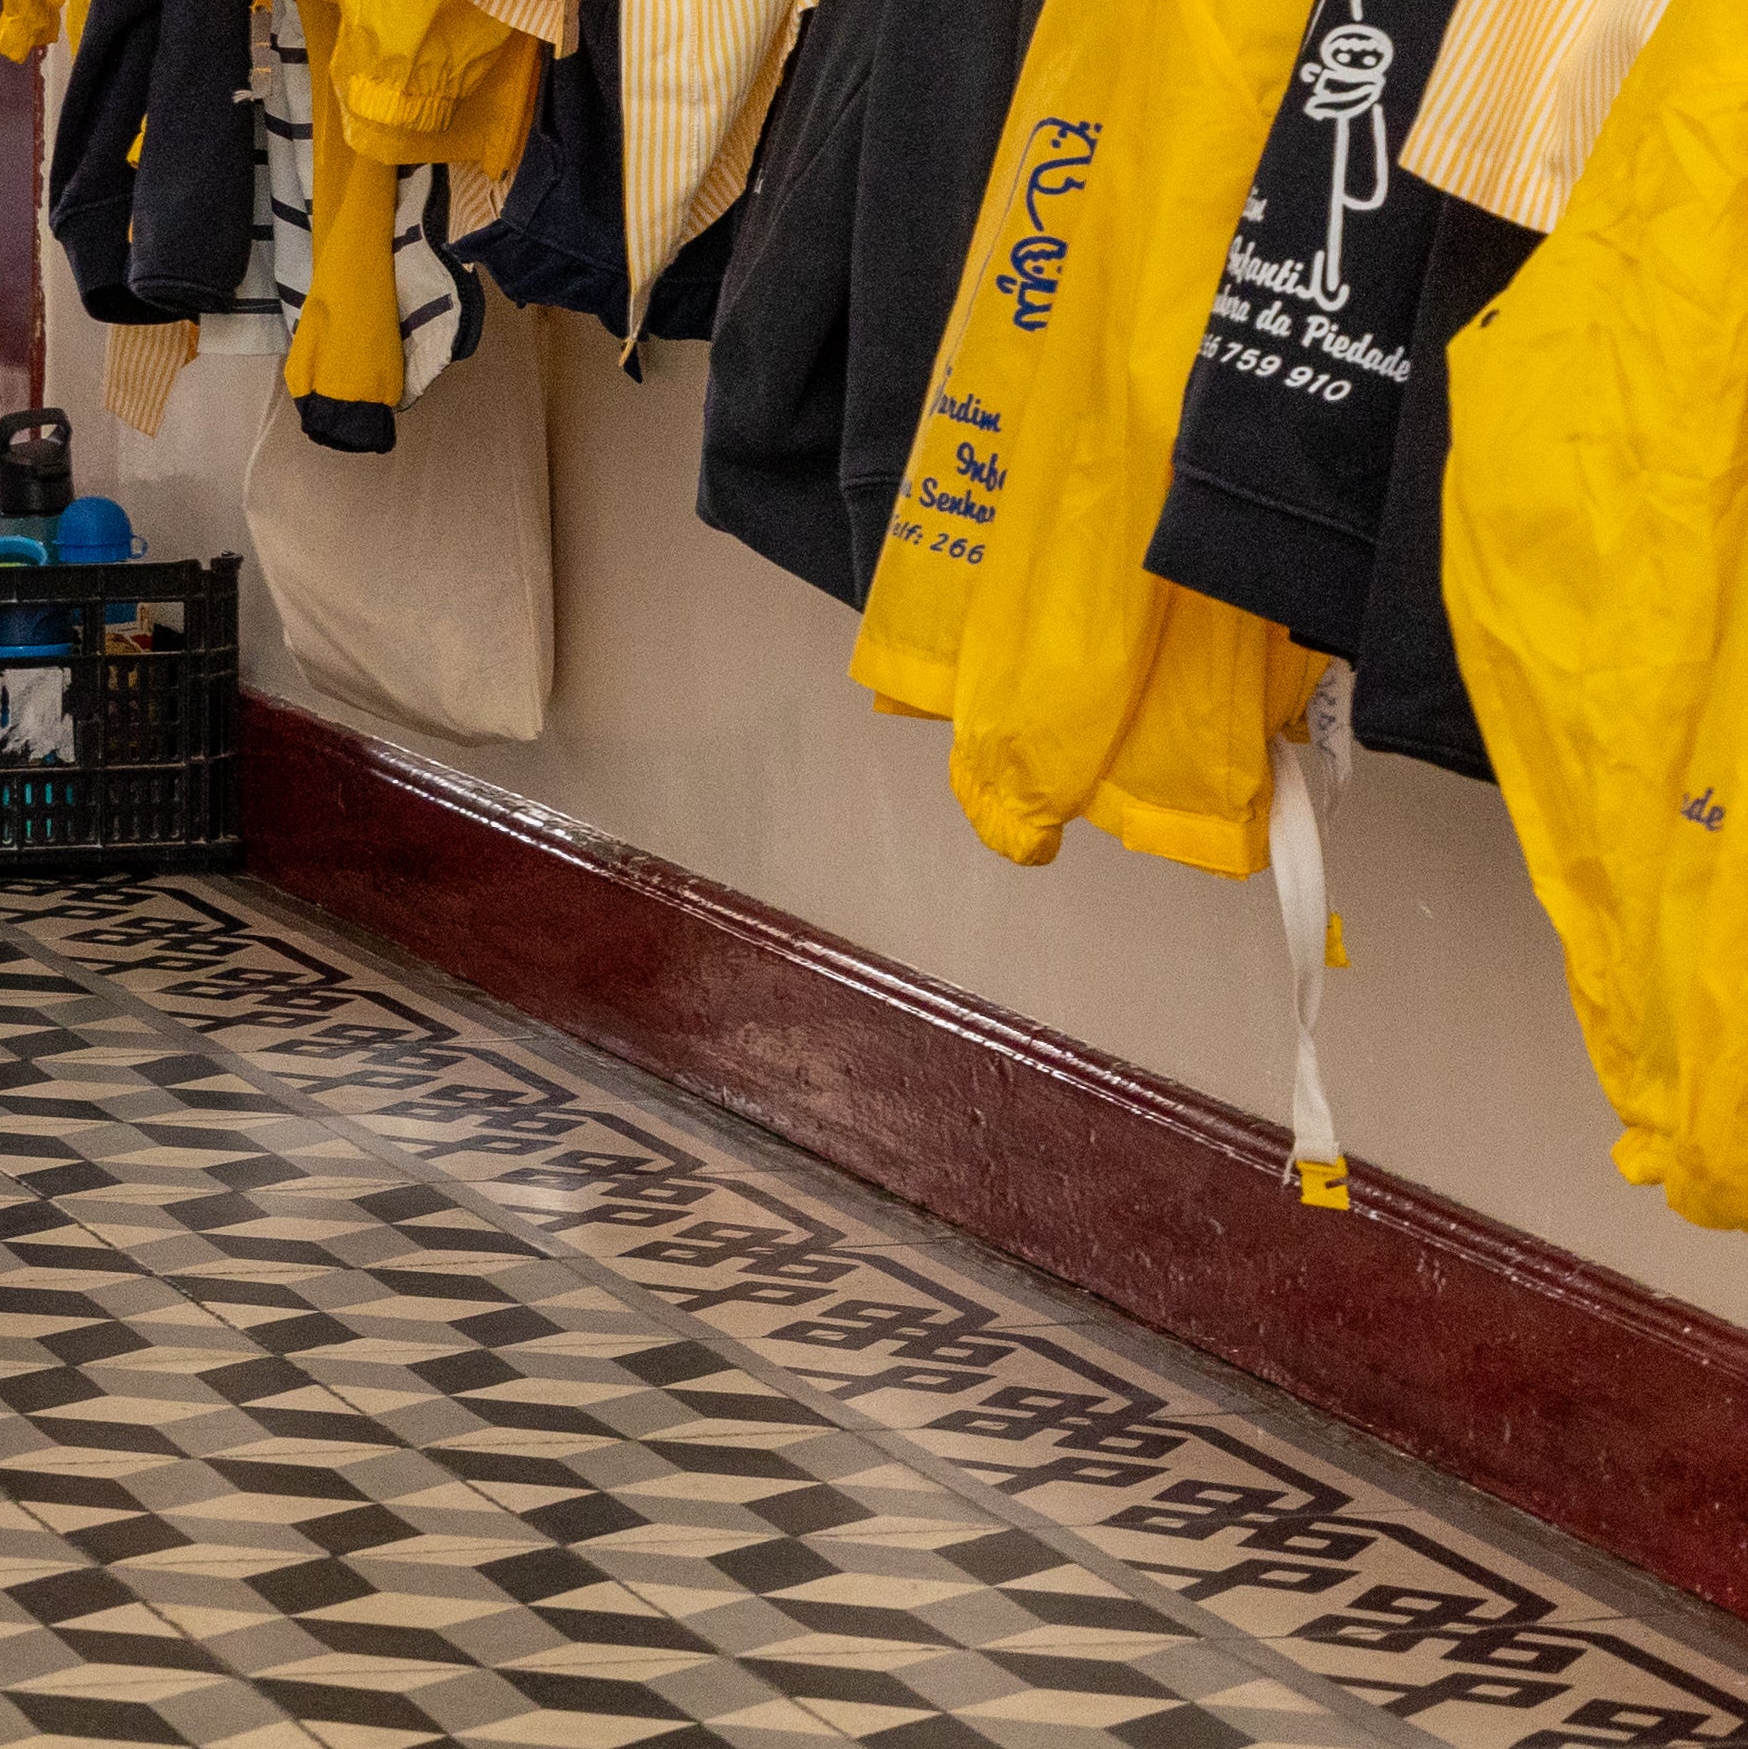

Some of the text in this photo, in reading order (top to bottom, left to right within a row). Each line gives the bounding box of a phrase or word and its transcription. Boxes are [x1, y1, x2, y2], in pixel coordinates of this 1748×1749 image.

[1219, 341, 1283, 378] 759
[1283, 365, 1353, 402] 910
[1255, 300, 1293, 338] da
[1301, 314, 1413, 383] Piedade
[929, 532, 986, 565] 266
